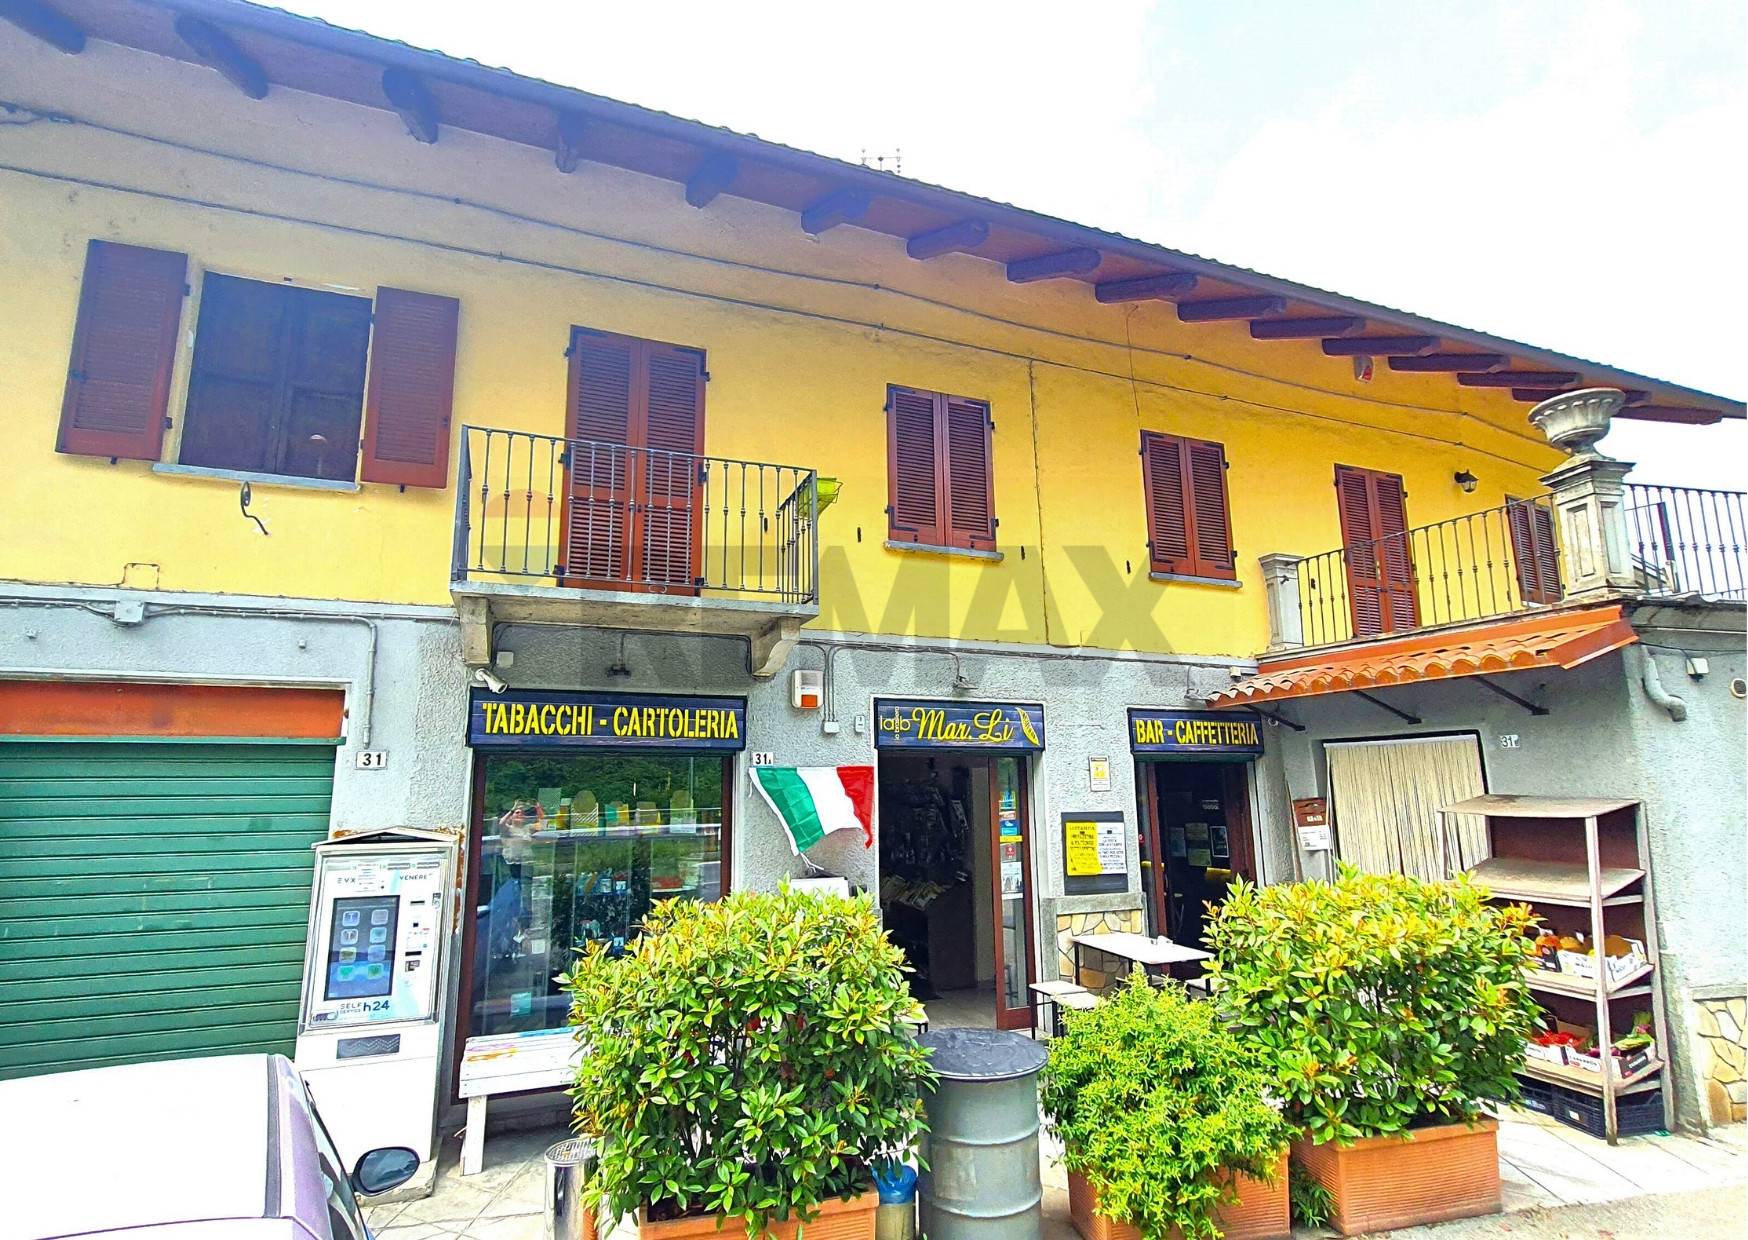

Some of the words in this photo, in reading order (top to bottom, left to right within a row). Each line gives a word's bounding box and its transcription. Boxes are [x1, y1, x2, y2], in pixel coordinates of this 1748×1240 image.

[482, 703, 592, 736] TABACCHI
[612, 706, 739, 739] CARTOLERIA
[973, 708, 1013, 742] Li
[1135, 719, 1165, 744] BAR
[1175, 720, 1258, 745] CAFFETTERIA
[363, 752, 382, 767] 31
[340, 1002, 362, 1010] SELF
[363, 999, 390, 1012] h24
